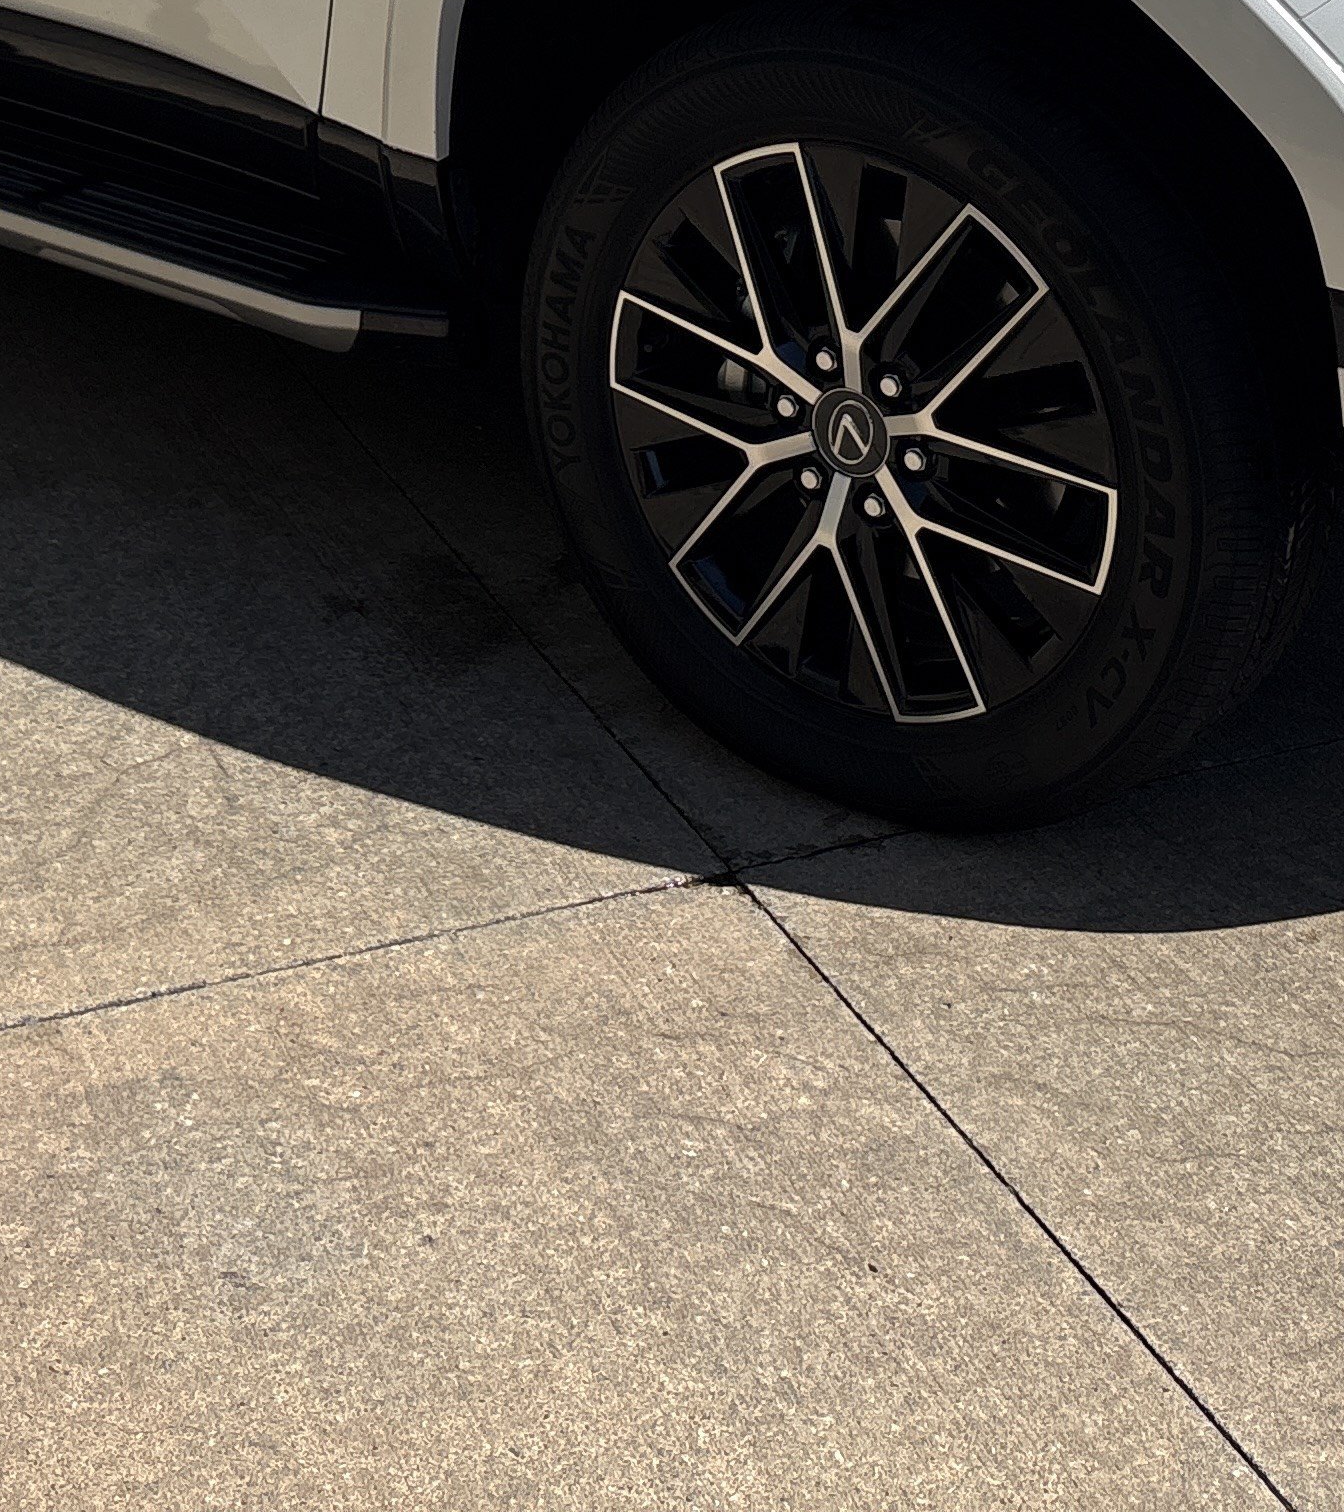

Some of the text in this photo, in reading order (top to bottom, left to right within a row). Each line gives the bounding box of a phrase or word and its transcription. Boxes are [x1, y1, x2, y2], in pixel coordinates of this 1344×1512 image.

[540, 224, 597, 474] YOKOHAMA
[967, 148, 1176, 600] GEOLANDAR
[1085, 602, 1157, 730] X-CV
